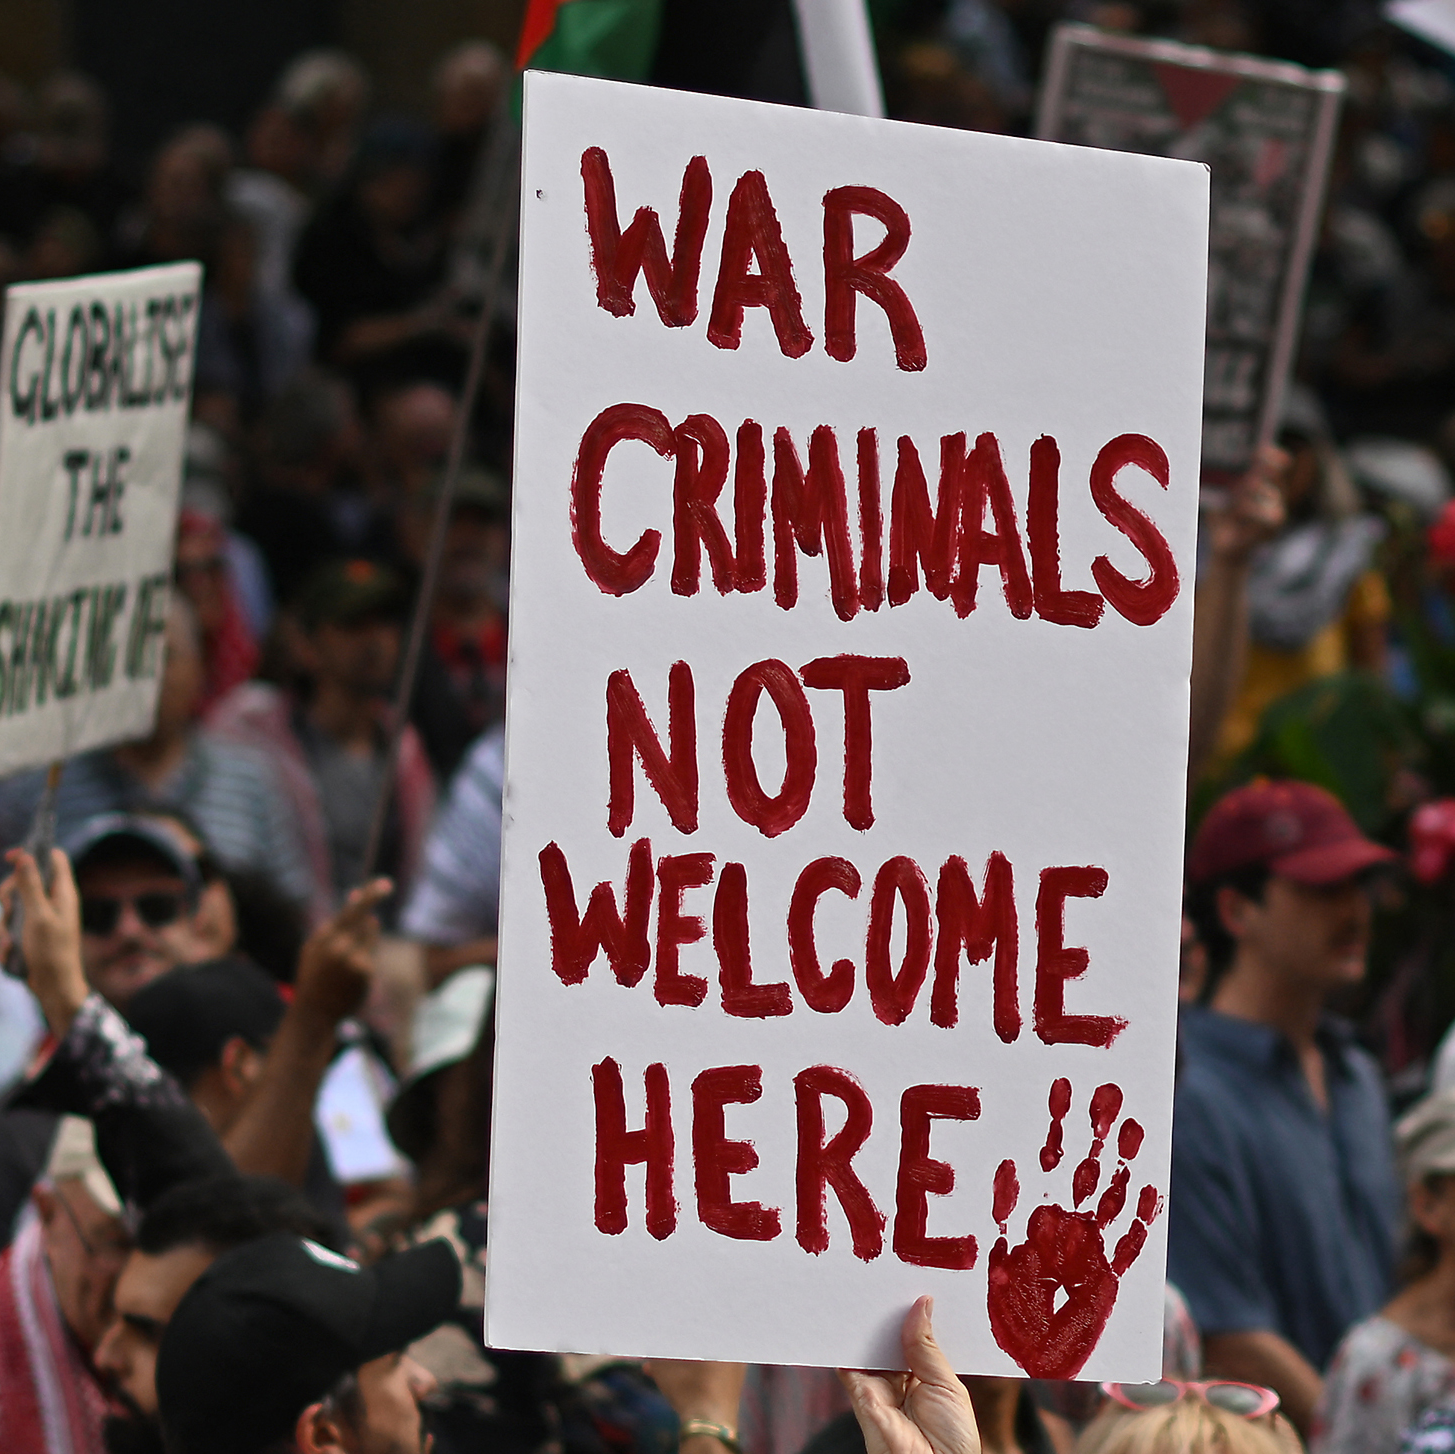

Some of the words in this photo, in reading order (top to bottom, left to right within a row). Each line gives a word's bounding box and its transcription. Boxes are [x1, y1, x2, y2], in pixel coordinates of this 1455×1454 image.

[579, 145, 928, 373] WAR
[63, 446, 132, 541] THE
[568, 401, 1181, 630] CRIMINALS
[605, 652, 912, 839] NOT
[537, 836, 1131, 1050] WELCOME
[590, 1055, 983, 1271] HERE
